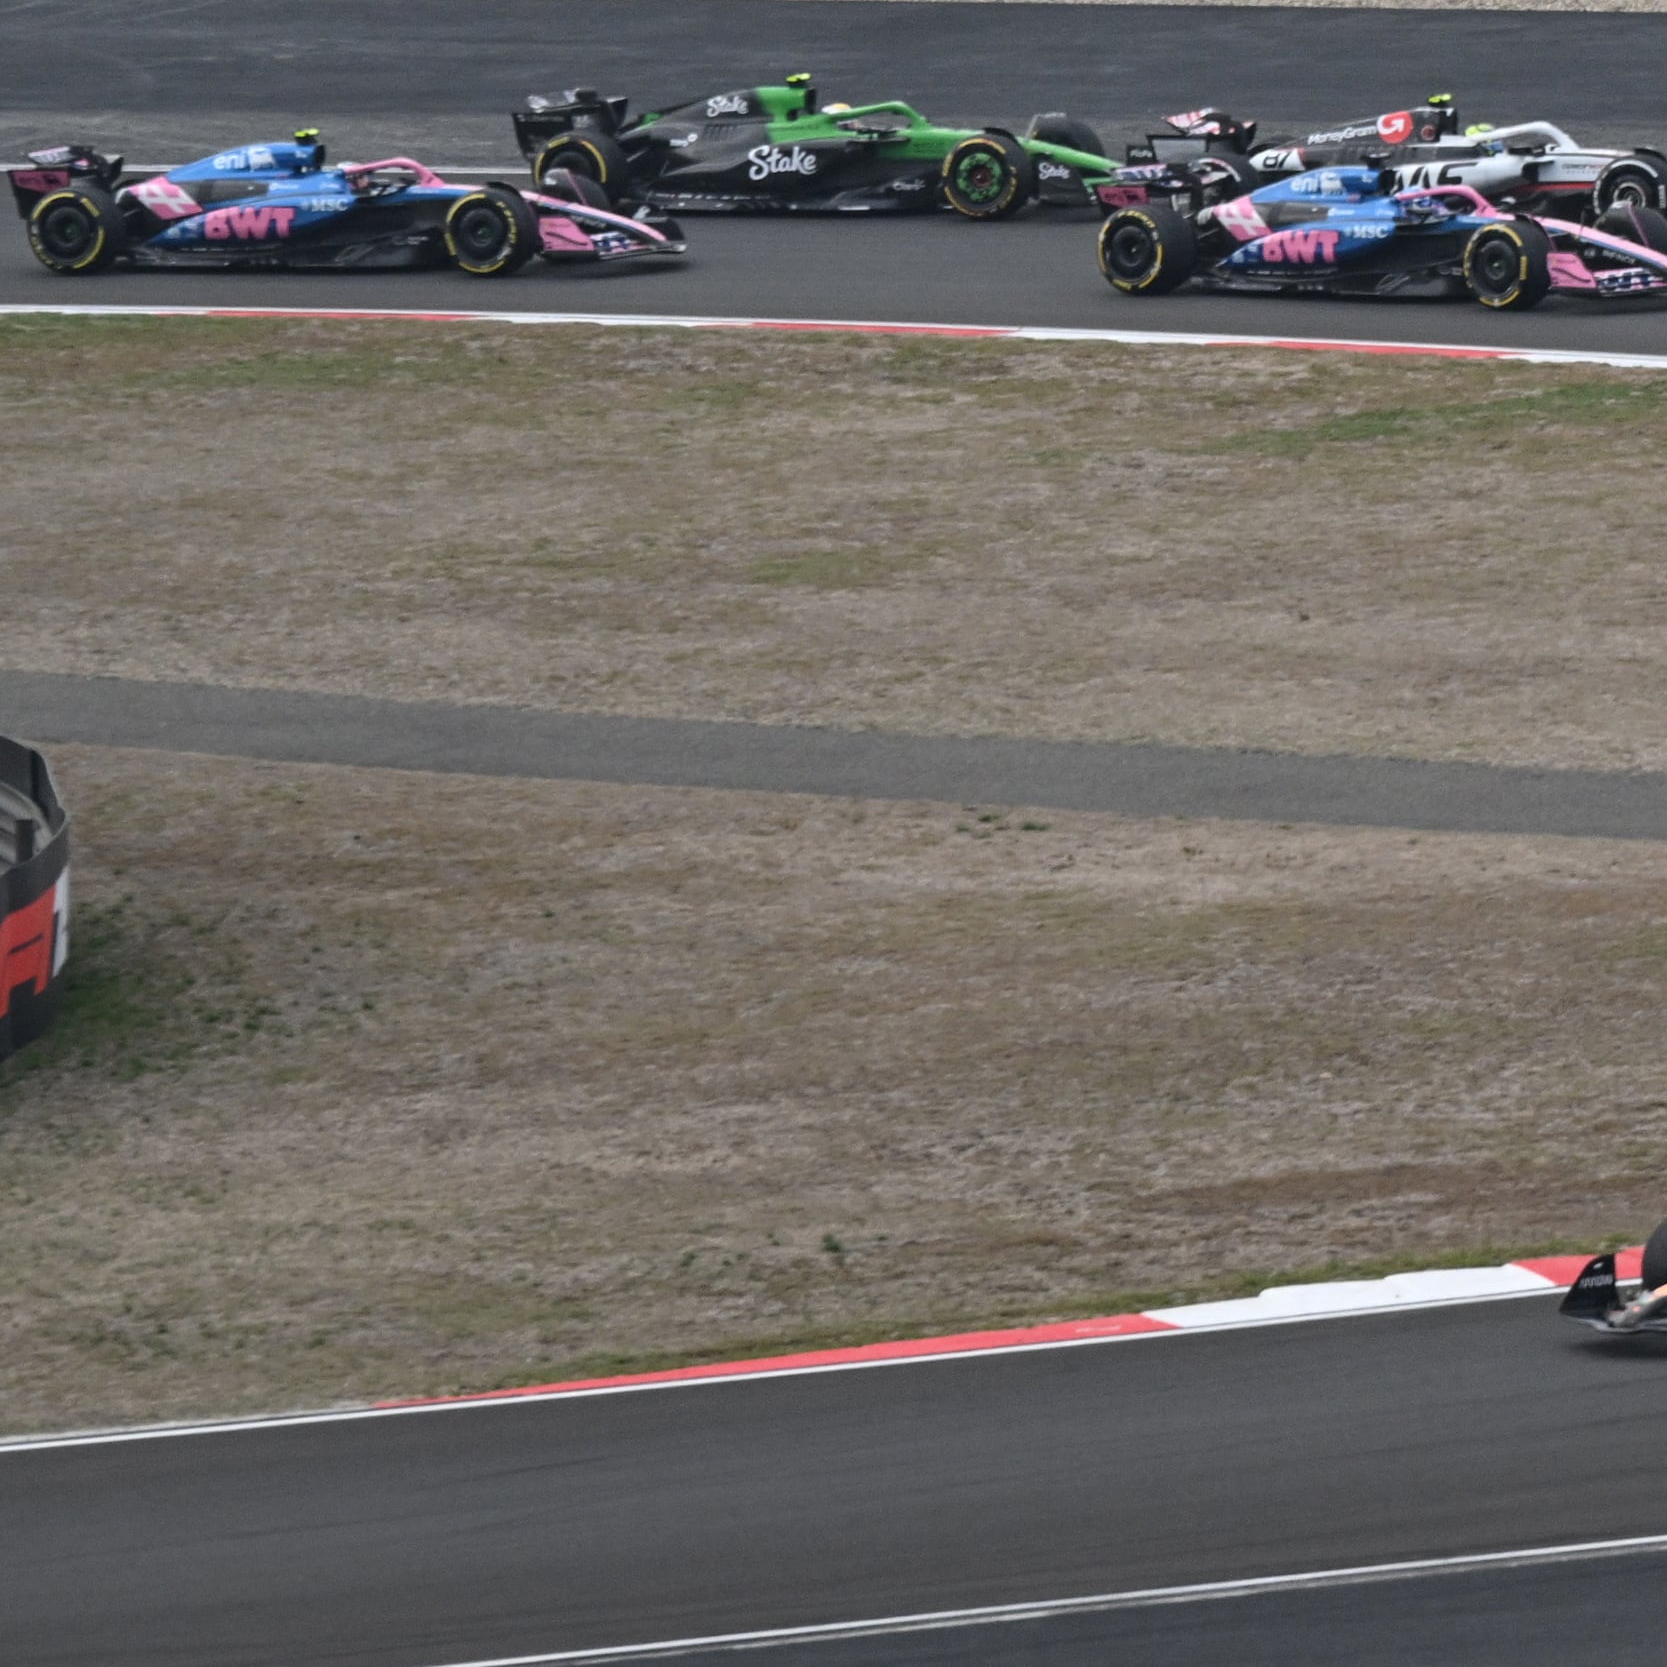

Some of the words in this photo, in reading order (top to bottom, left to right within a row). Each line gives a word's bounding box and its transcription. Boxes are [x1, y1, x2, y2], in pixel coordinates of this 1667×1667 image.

[707, 96, 749, 118] Stake
[1308, 125, 1378, 145] MoneyGram
[213, 148, 248, 170] eni
[748, 145, 817, 180] Stake
[1039, 161, 1072, 180] Stake
[1290, 175, 1318, 192] eni
[311, 198, 349, 212] MSC
[204, 206, 296, 240] BWT
[1354, 225, 1389, 239] MSC
[1262, 230, 1340, 264] BWT
